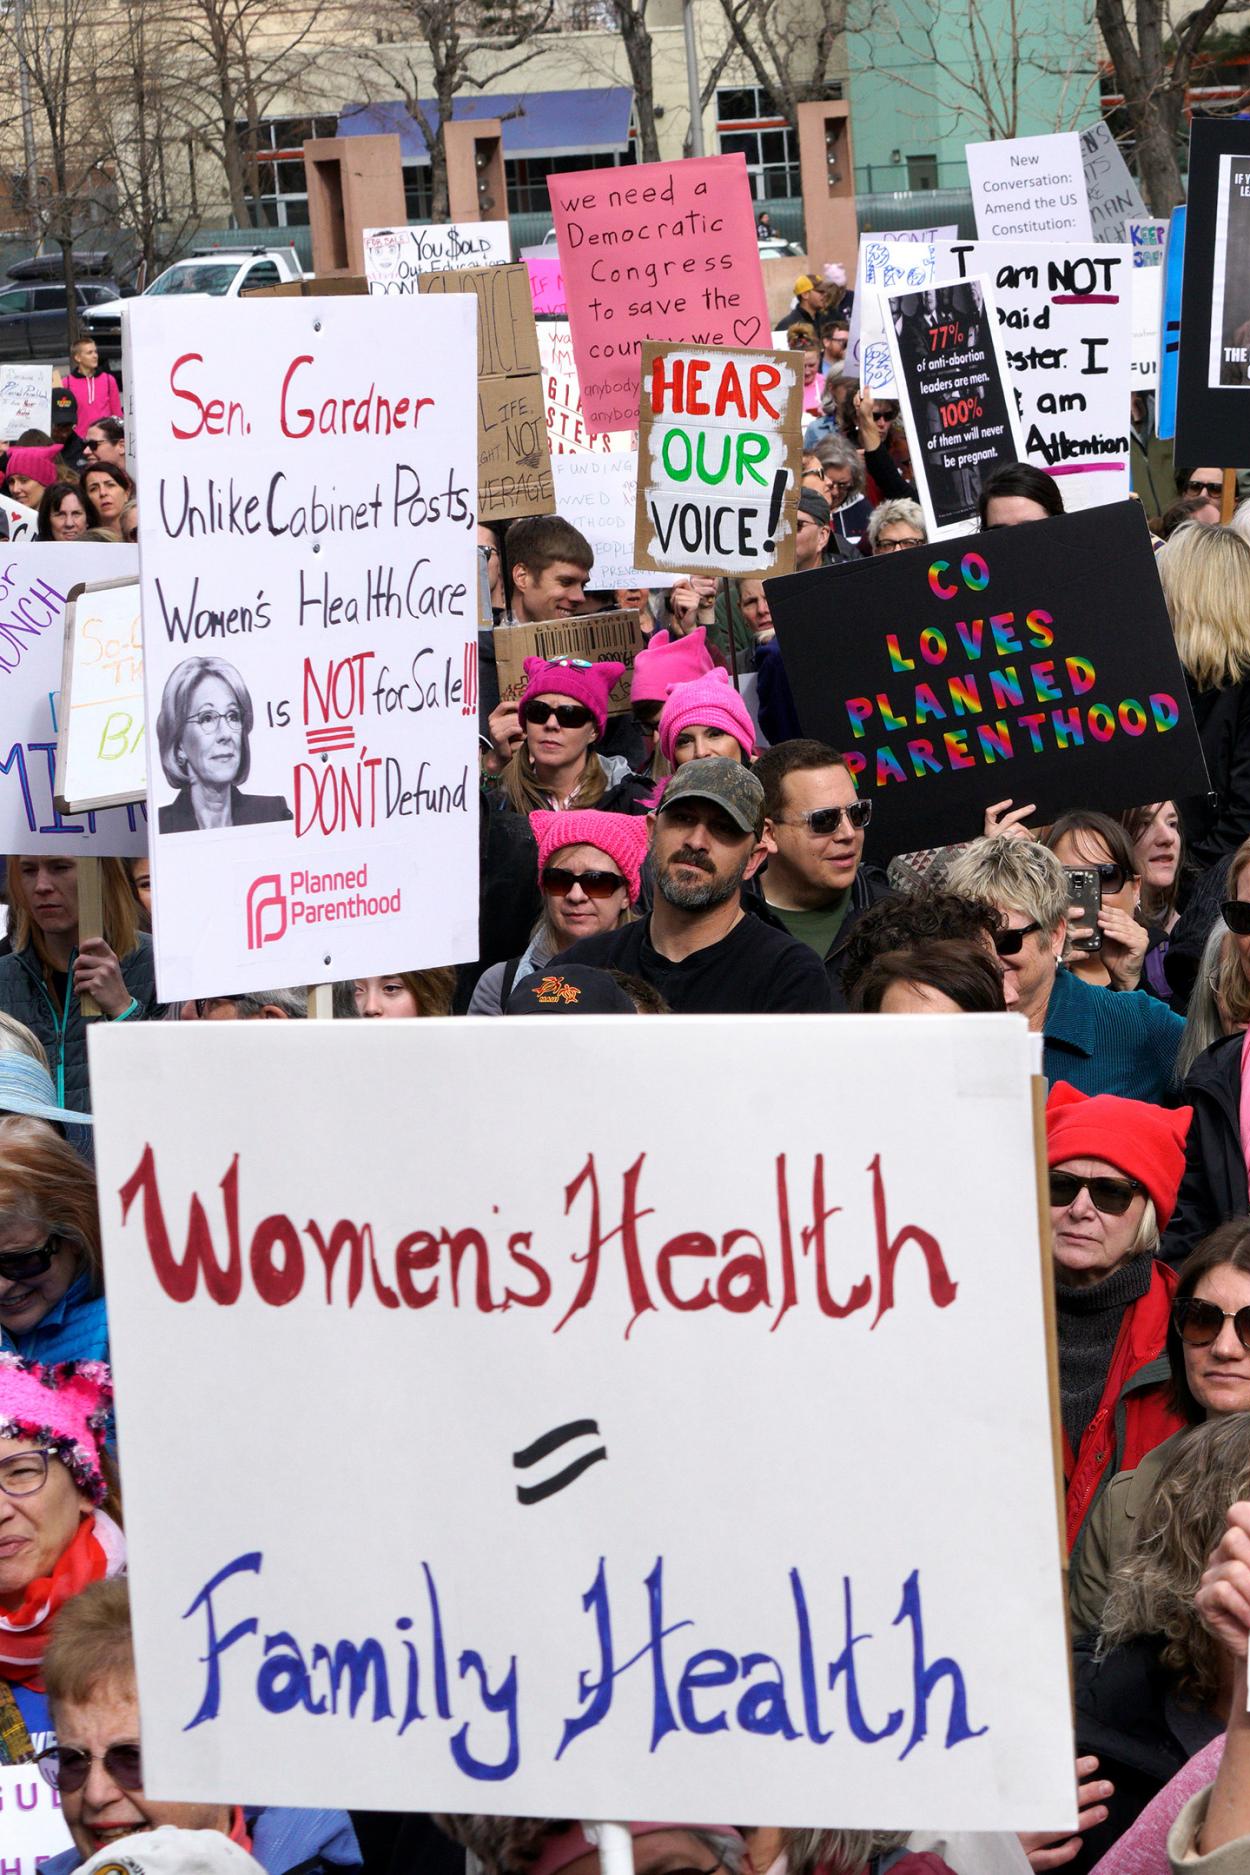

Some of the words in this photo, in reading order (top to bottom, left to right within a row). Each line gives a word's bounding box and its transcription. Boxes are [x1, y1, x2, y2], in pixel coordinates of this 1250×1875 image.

[1010, 154, 1040, 168] New
[1235, 174, 1244, 185] IF
[561, 194, 597, 212] we
[609, 174, 674, 206] need
[694, 182, 707, 195] a
[982, 174, 1073, 194] Conversation:
[985, 200, 1032, 215] Amend
[1034, 197, 1057, 210] the
[1059, 194, 1078, 207] US
[567, 210, 723, 249] Democratic
[991, 217, 1077, 237] Constitution:
[1130, 225, 1165, 246] KEEP
[591, 254, 733, 287] Congress
[996, 266, 1039, 289] am
[1048, 258, 1121, 295] NOT
[589, 298, 614, 322] to
[628, 297, 687, 317] save
[702, 287, 740, 310] the
[929, 322, 964, 352] 77%
[1224, 347, 1248, 363] THE
[917, 358, 928, 373] of
[928, 350, 984, 371] anti-abortion
[1081, 338, 1109, 375] I
[170, 352, 252, 440] Sen.
[280, 355, 435, 440] Gardner
[651, 355, 781, 422] HEAR
[920, 377, 952, 395] leaders
[954, 375, 968, 388] are
[970, 371, 990, 385] men.
[940, 397, 983, 428] 100%
[1037, 392, 1087, 415] am
[506, 417, 542, 461] NOT
[927, 437, 938, 450] of
[939, 431, 962, 446] them
[963, 427, 979, 443] will
[980, 424, 1004, 440] never
[662, 427, 771, 487] OUR
[944, 454, 957, 468] be
[958, 446, 998, 469] pregnant.
[160, 473, 260, 539] Unlike
[268, 471, 382, 538] Cabinet
[395, 463, 476, 531] Posts,
[650, 469, 789, 557] VOICE!
[928, 552, 990, 600] CO
[155, 576, 273, 644] Women's
[885, 609, 1054, 673] LOVES
[303, 651, 375, 725] NOT
[372, 666, 409, 716] for
[844, 656, 1096, 739] PLANNED
[842, 692, 1179, 790] PARENTHOOD
[293, 746, 382, 838] DON'T
[386, 757, 467, 818] Defund
[291, 863, 368, 896] Planned
[291, 888, 401, 925] Parenthood
[119, 1141, 553, 1313] Women's
[553, 1150, 959, 1340] Health
[182, 1550, 521, 1782] Family
[555, 1555, 990, 1762] Health
